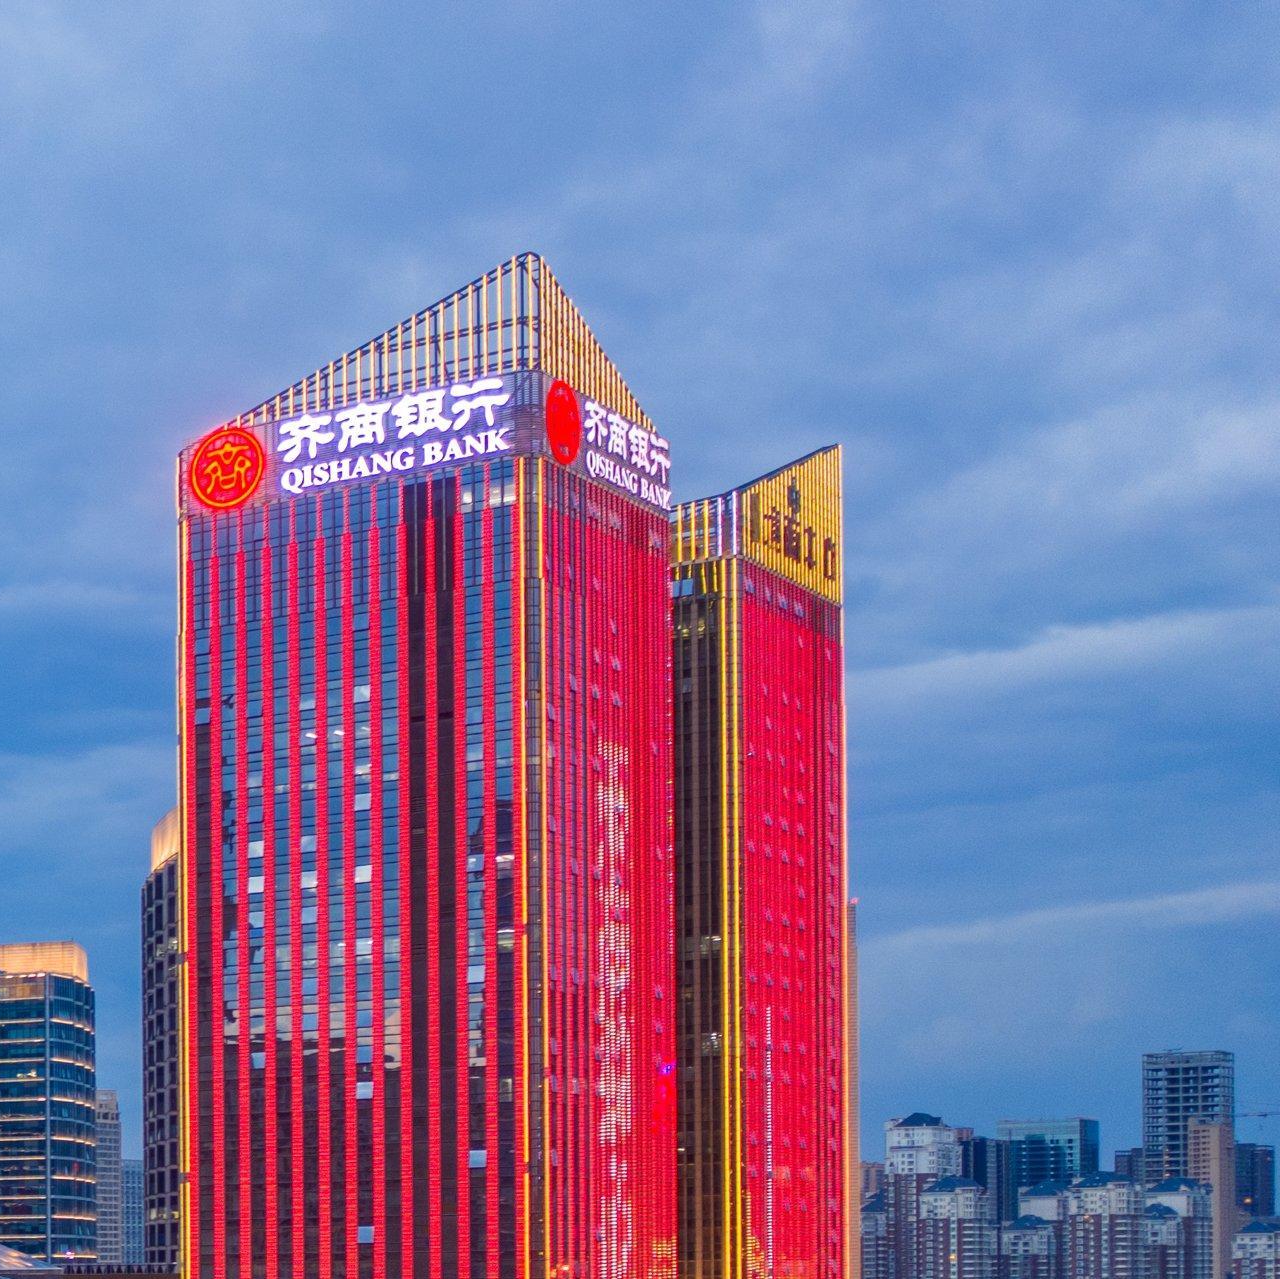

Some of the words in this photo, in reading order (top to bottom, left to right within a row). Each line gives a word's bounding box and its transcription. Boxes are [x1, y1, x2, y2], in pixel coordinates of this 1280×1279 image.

[277, 377, 513, 463] 齐商银行
[584, 401, 671, 485] 齐商银行
[281, 447, 416, 494] QISHANG
[421, 427, 515, 466] BANK
[586, 450, 639, 494] QISHANG
[640, 477, 672, 511] BANK
